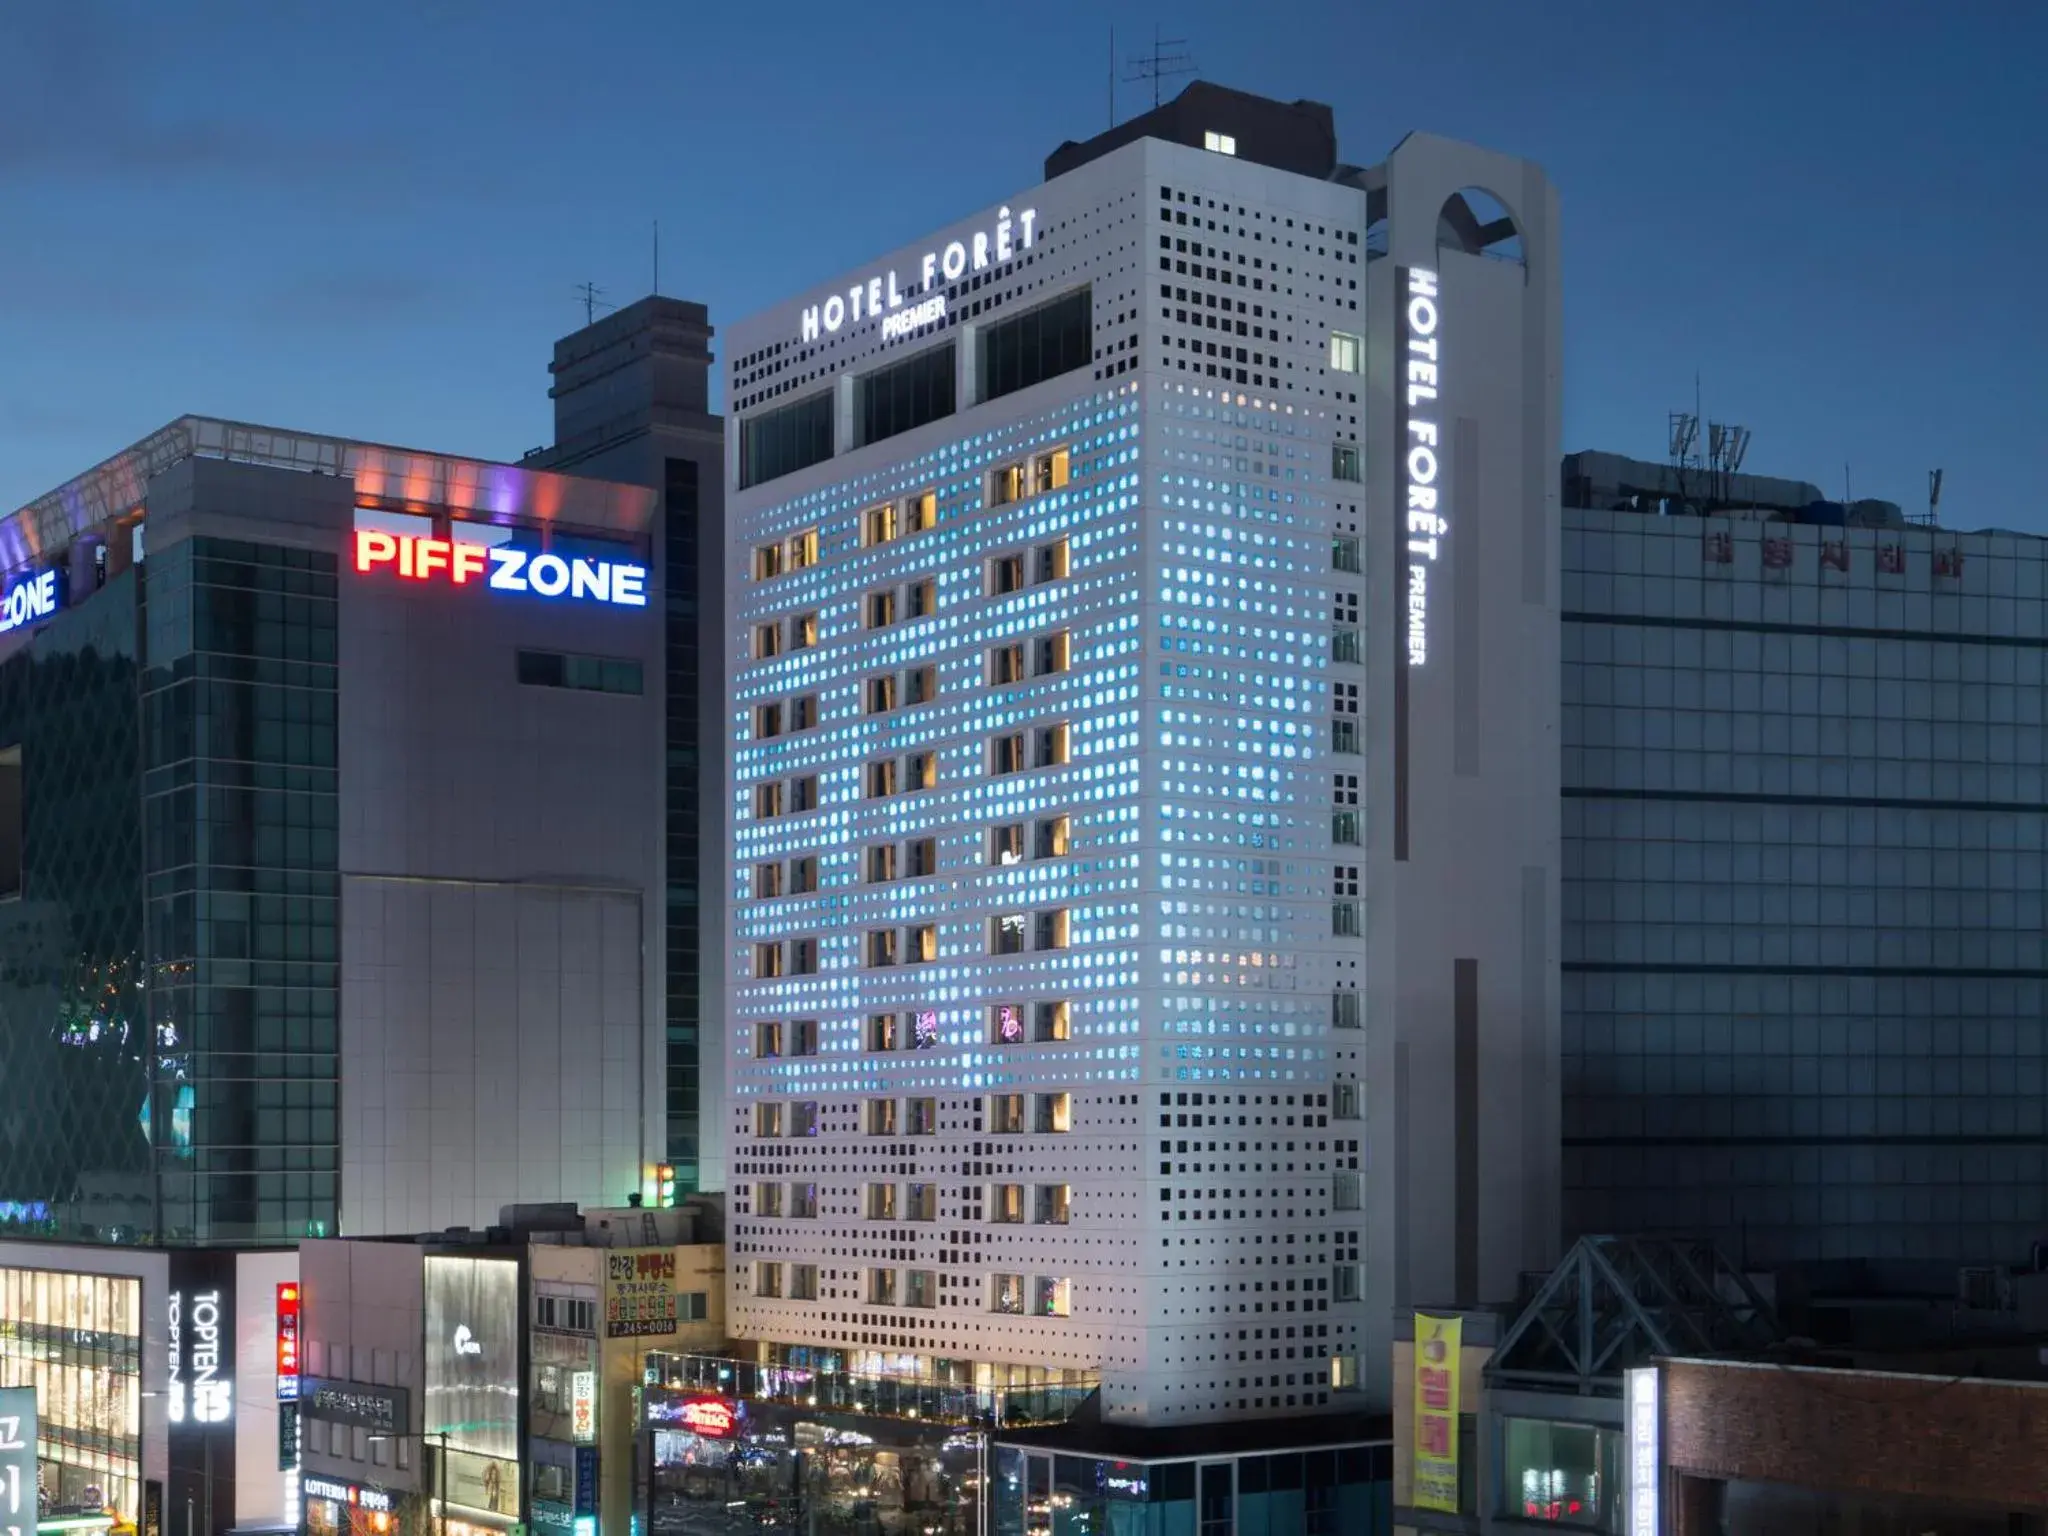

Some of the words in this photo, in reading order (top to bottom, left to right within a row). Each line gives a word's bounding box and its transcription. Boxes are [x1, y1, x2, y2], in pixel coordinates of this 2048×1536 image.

[802, 270, 902, 343] HOTEL
[922, 205, 1036, 292] FORÊT
[882, 295, 946, 341] PREMIER
[1408, 267, 1438, 406] HOTEL
[1408, 418, 1448, 561] FORÊT
[355, 530, 647, 606] PIFFZONE
[1409, 564, 1426, 667] PREMIER
[305, 1479, 348, 1501] LOTTERIA
